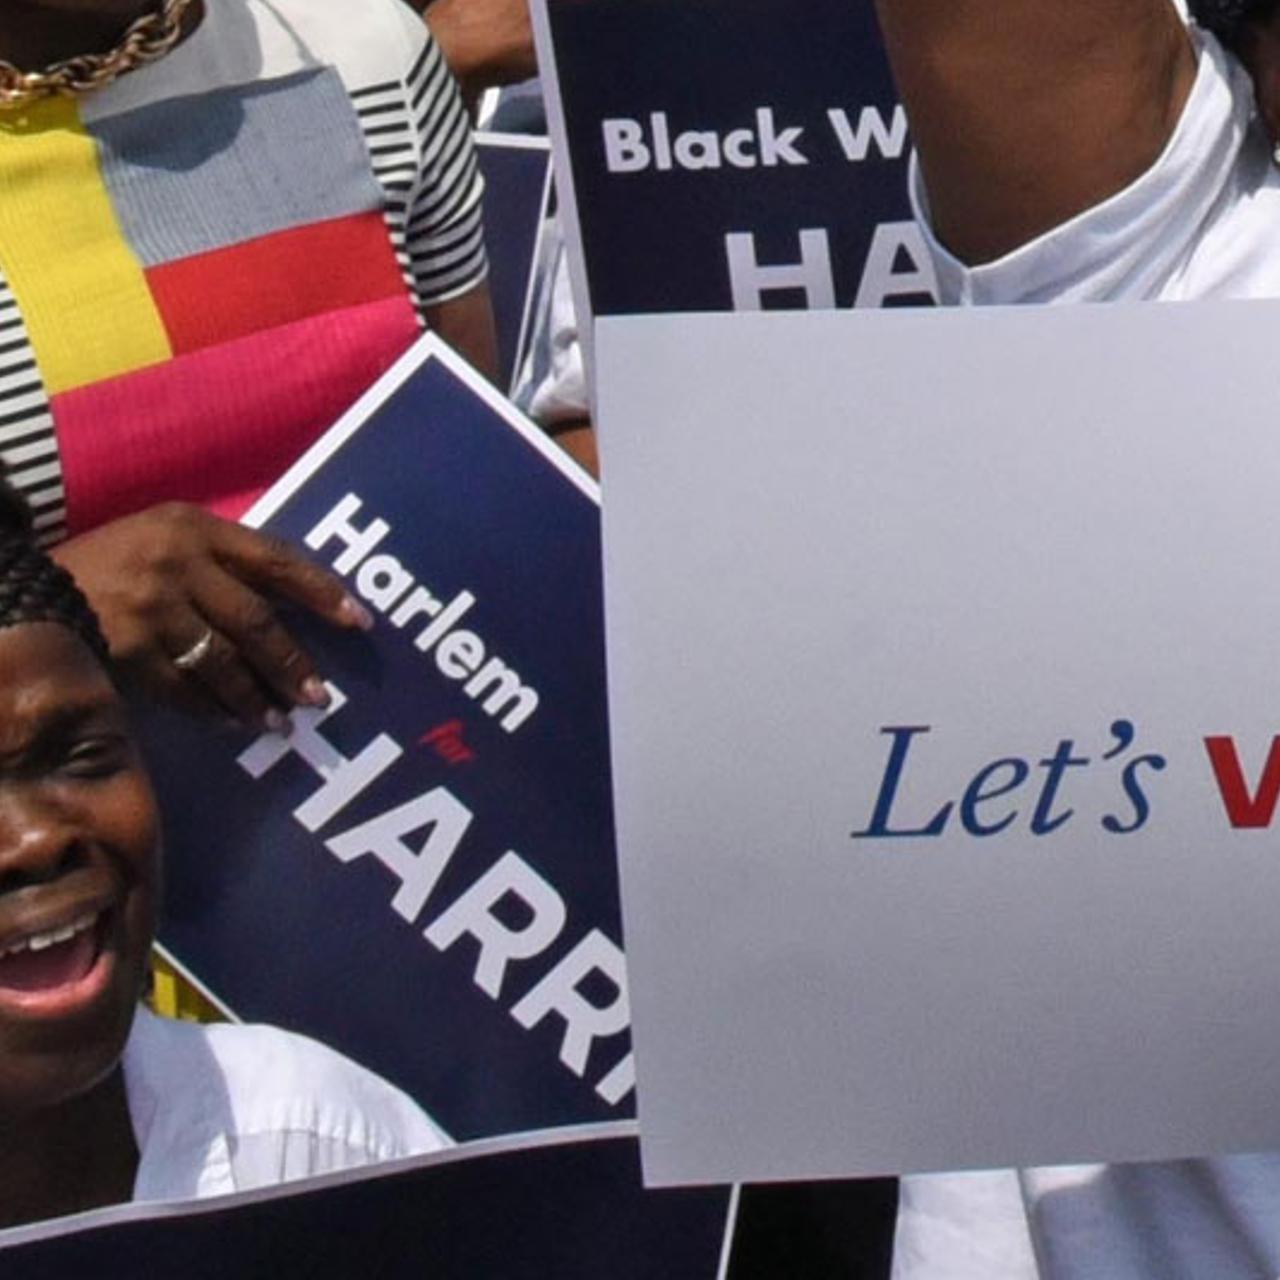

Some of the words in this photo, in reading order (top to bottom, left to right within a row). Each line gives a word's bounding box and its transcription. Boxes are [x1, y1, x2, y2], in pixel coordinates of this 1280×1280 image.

[602, 107, 809, 172] Black
[304, 492, 540, 733] Harlem
[236, 681, 636, 1106] HARR
